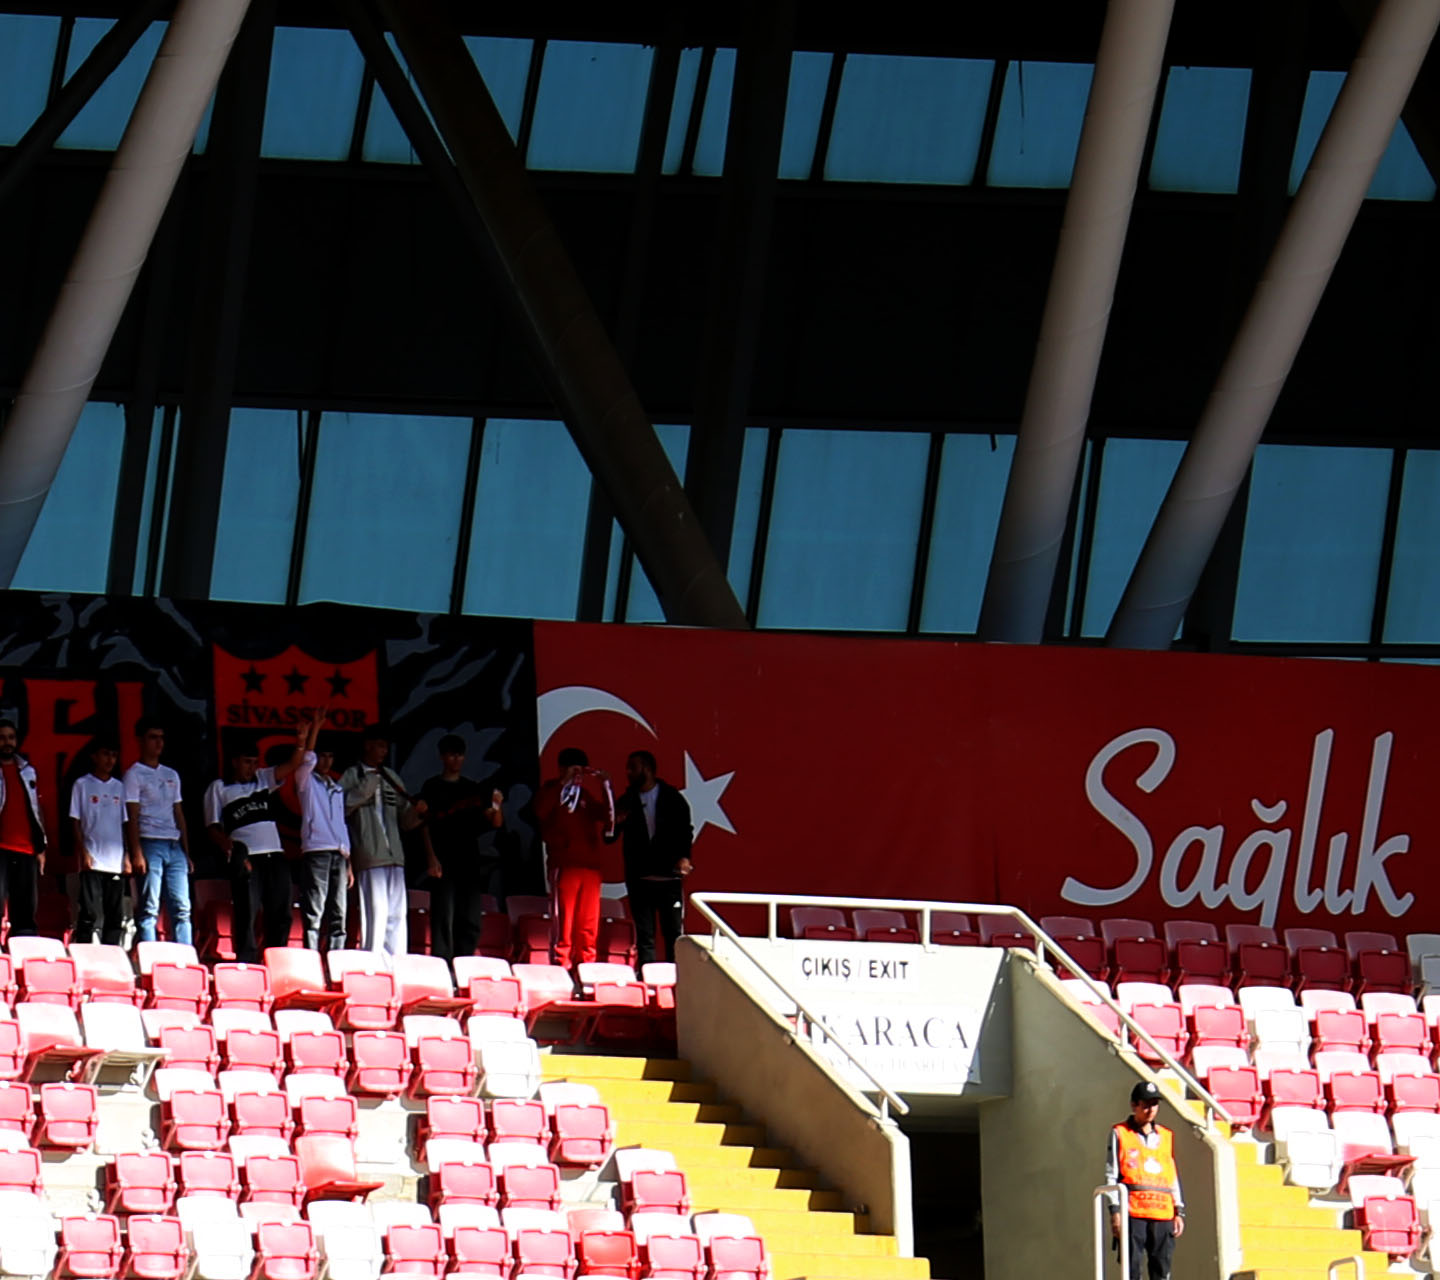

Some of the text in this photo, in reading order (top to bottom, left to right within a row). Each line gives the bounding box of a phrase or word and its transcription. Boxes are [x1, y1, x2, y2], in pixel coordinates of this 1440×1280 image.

[227, 698, 367, 728] SİVASSOR
[1060, 727, 1415, 928] Sağlık
[801, 957, 851, 983] ÇIKIŞ
[868, 960, 909, 979] EXIT
